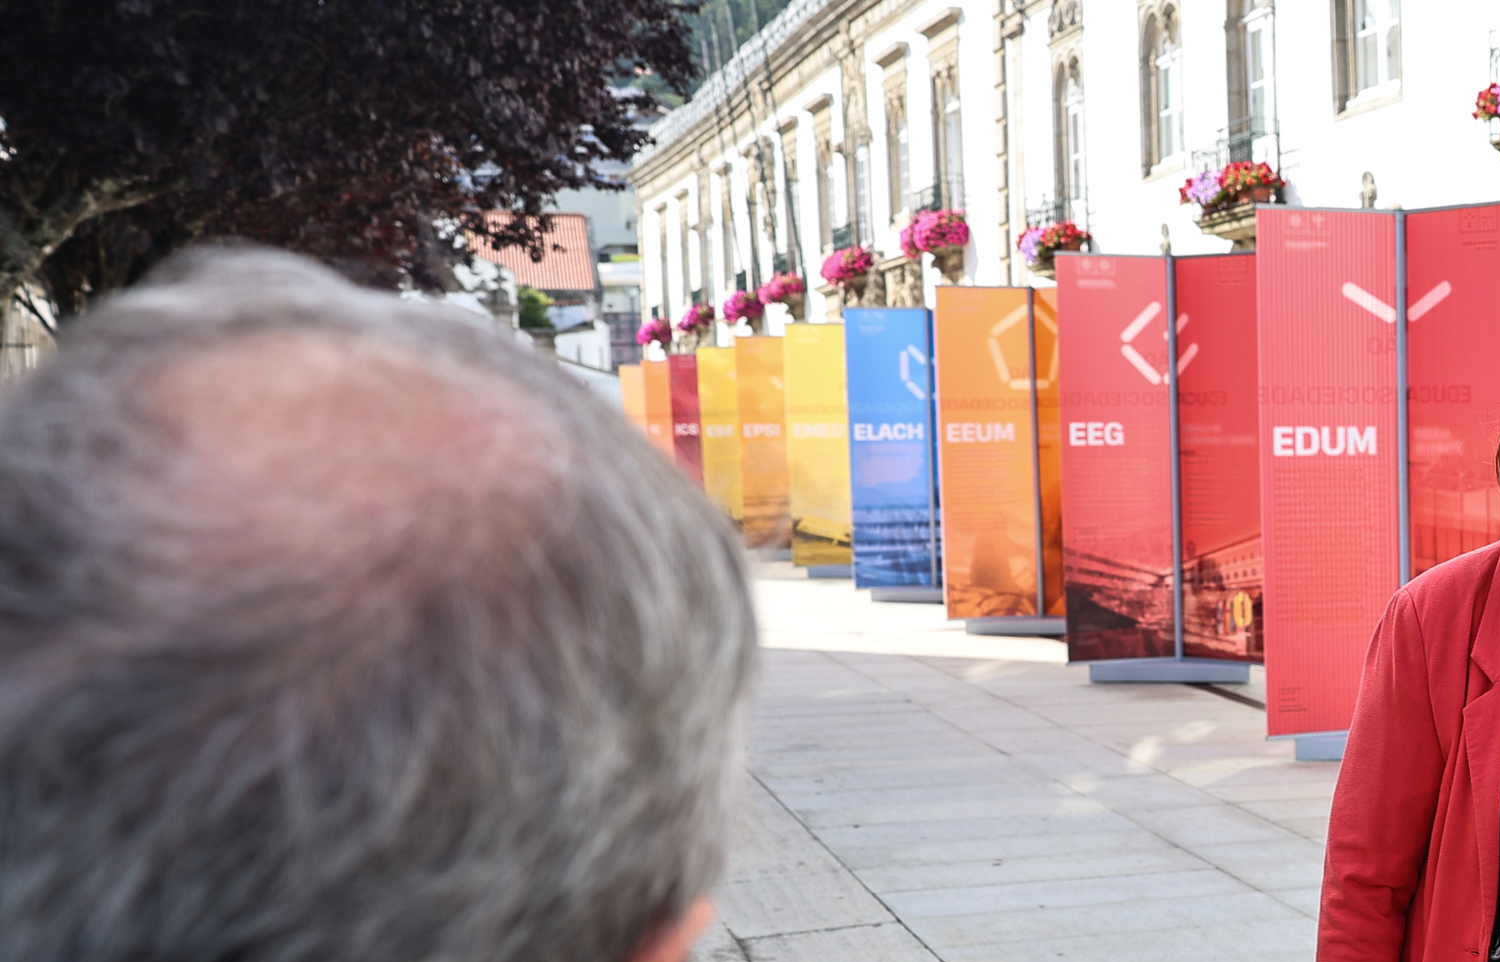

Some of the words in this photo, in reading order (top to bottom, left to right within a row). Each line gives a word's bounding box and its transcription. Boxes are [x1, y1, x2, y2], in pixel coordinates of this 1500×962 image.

[742, 423, 781, 438] EPSI
[854, 422, 925, 441] ELACH
[946, 423, 1016, 443] EEUM
[1068, 421, 1125, 446] EEG
[1272, 425, 1378, 457] EDUM
